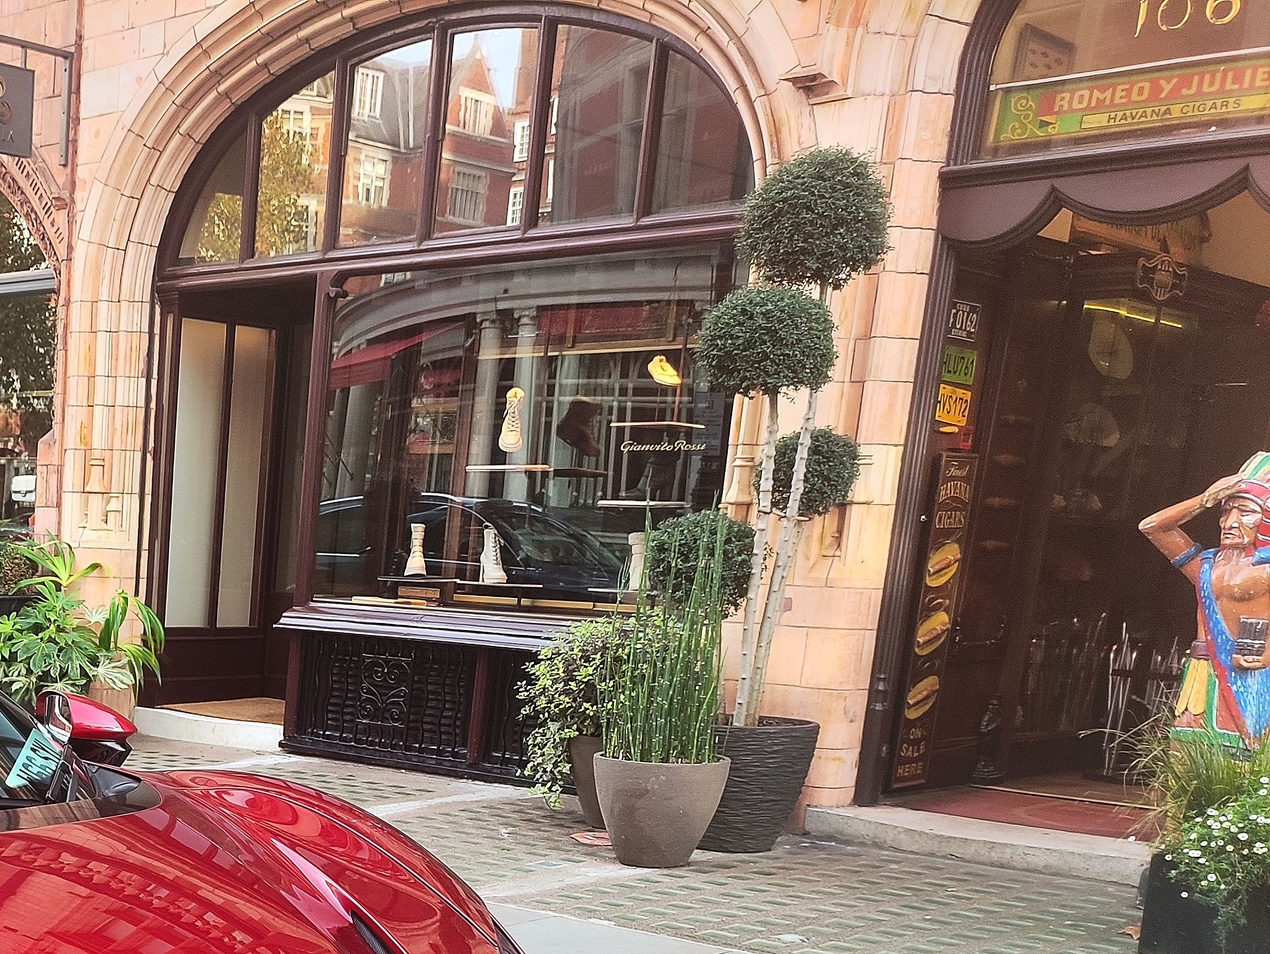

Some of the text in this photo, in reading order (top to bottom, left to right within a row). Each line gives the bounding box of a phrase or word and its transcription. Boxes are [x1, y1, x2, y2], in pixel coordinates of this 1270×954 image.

[1054, 82, 1150, 111] ROMEO
[1159, 77, 1179, 98] Y
[1107, 98, 1241, 124] HAVANA CIGARS
[620, 440, 706, 453] Gianvito Rossi
[938, 481, 970, 503] HAVANA
[936, 511, 965, 528] CIGARS
[910, 728, 922, 739] ON
[900, 741, 925, 757] SALE
[897, 762, 923, 777] HERE
